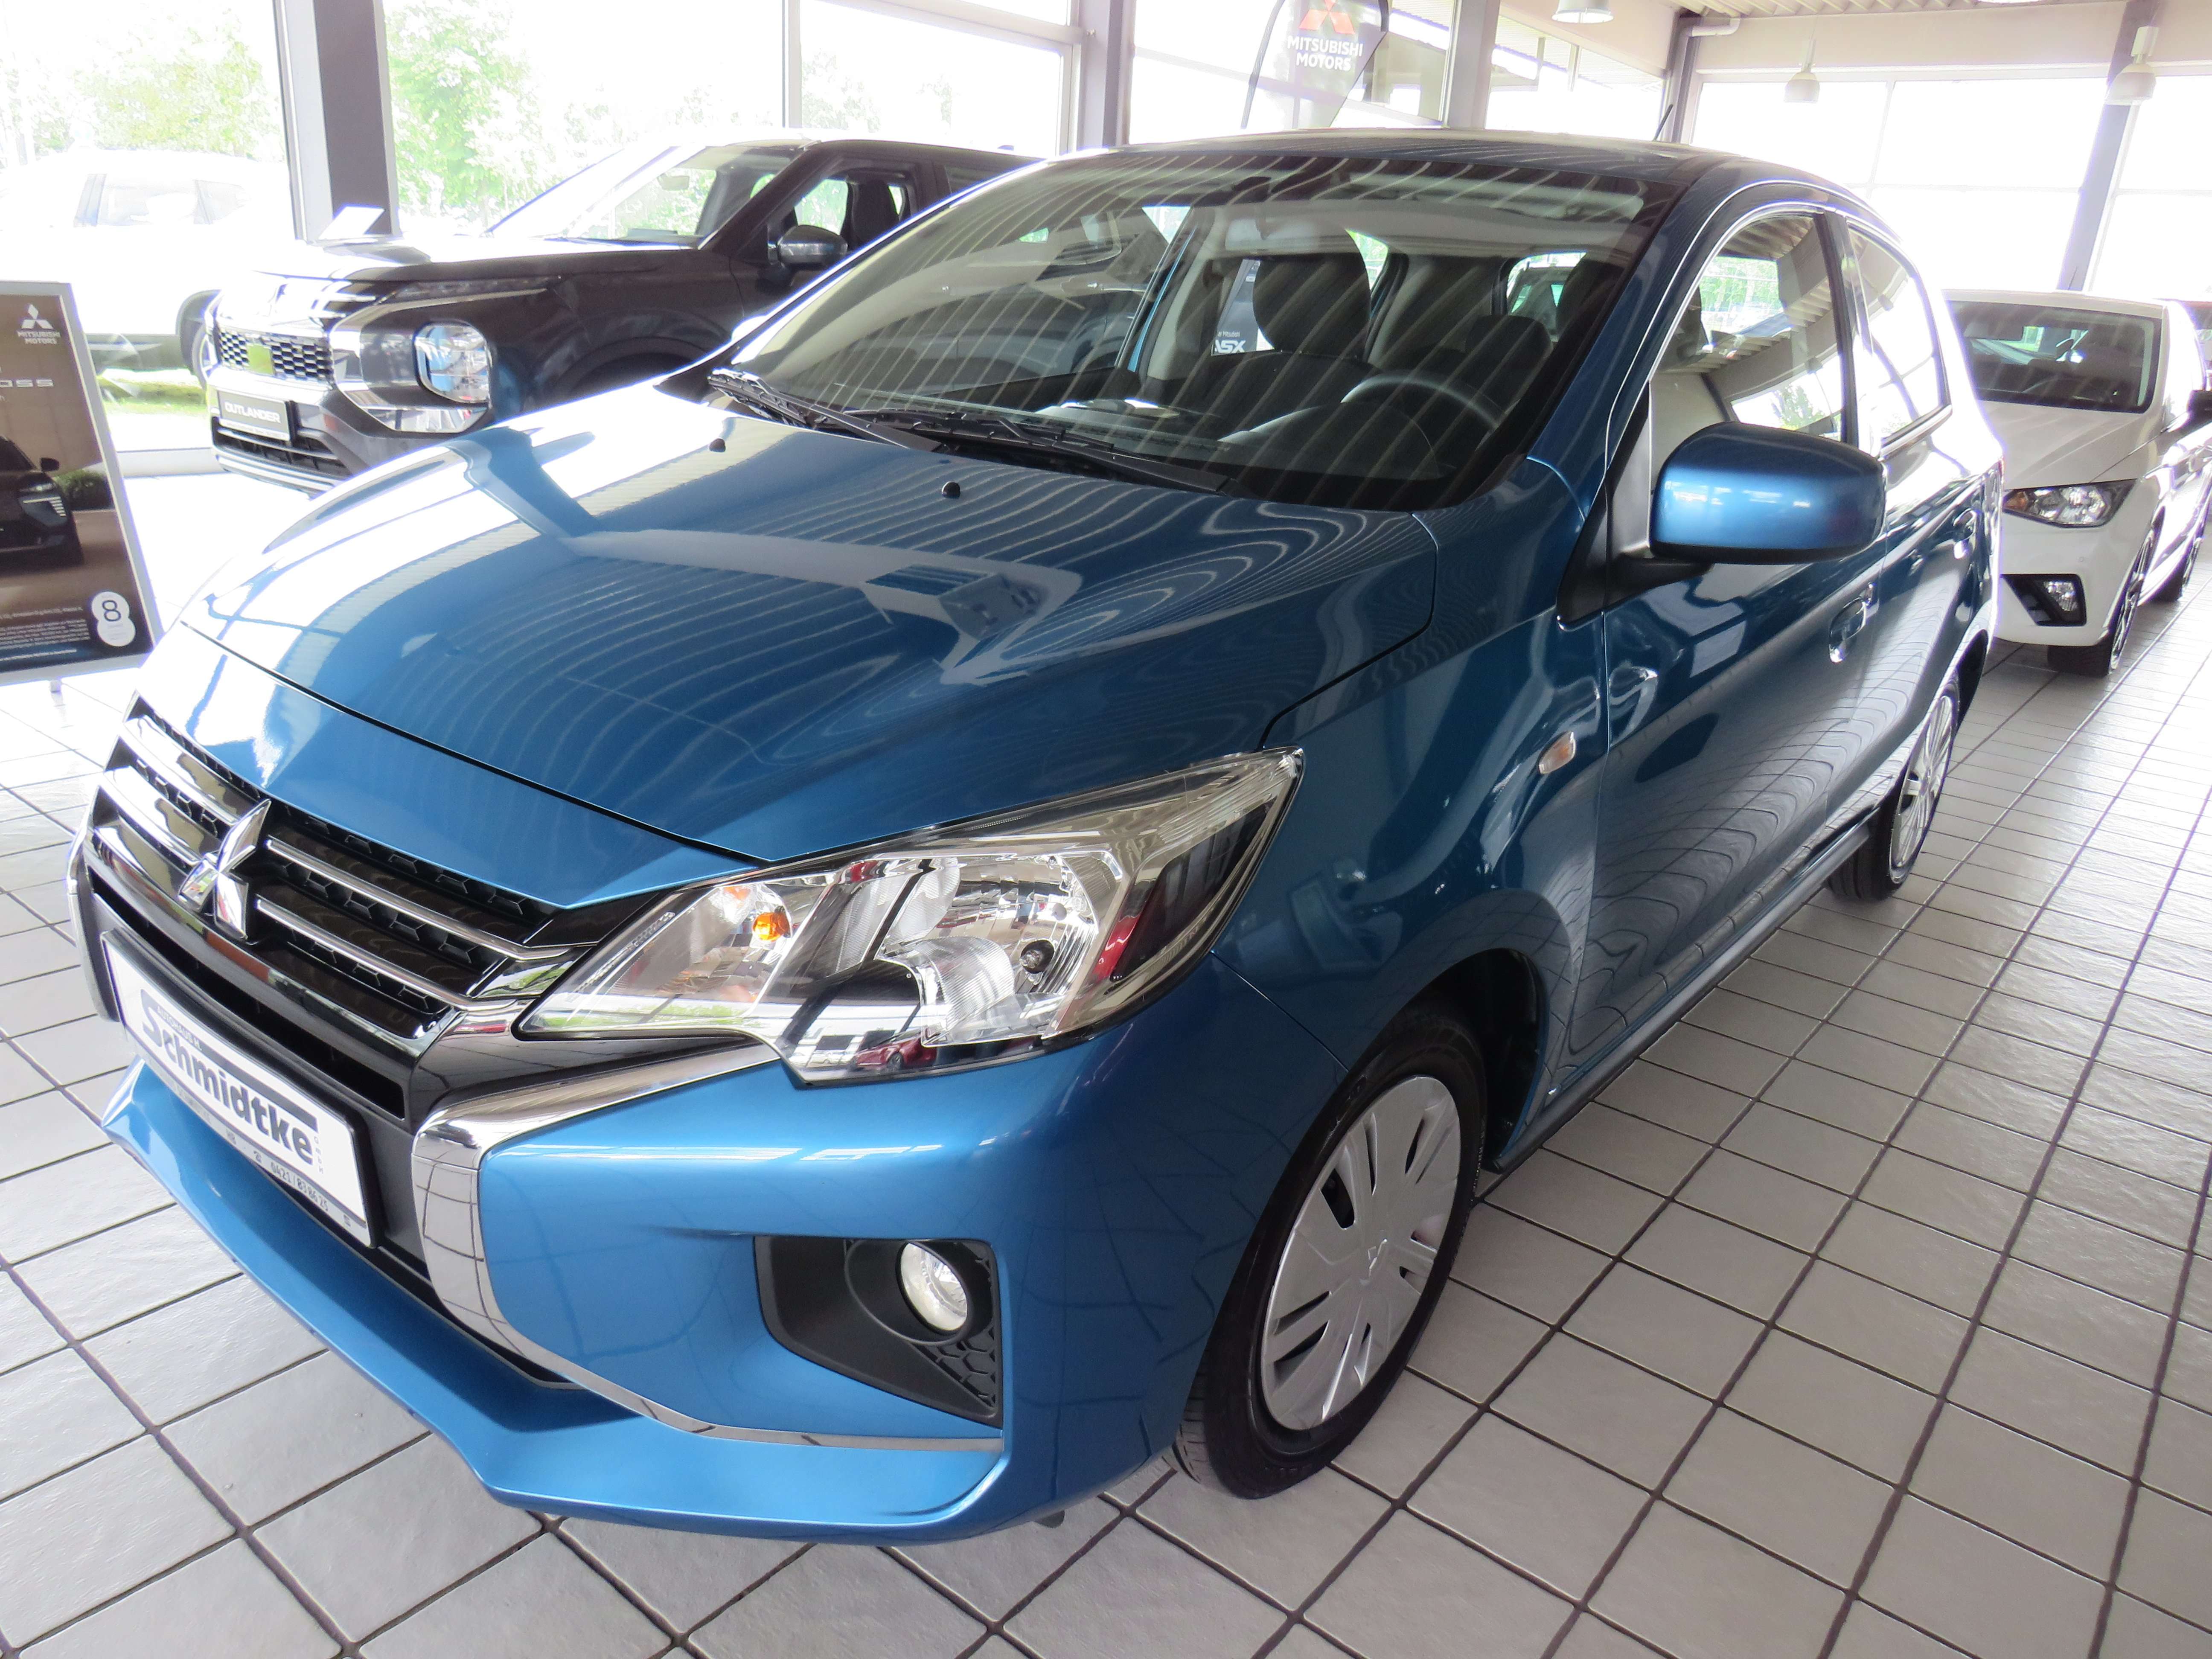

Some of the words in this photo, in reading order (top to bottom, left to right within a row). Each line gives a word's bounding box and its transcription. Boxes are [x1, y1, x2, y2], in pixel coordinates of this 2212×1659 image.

[1287, 35, 1363, 57] MITSUBISHI
[1295, 52, 1351, 71] MOTORS
[1214, 340, 1246, 353] ASX
[224, 402, 281, 424] OUTLANDER
[102, 600, 122, 622] 8
[140, 989, 313, 1165] Schmidtke
